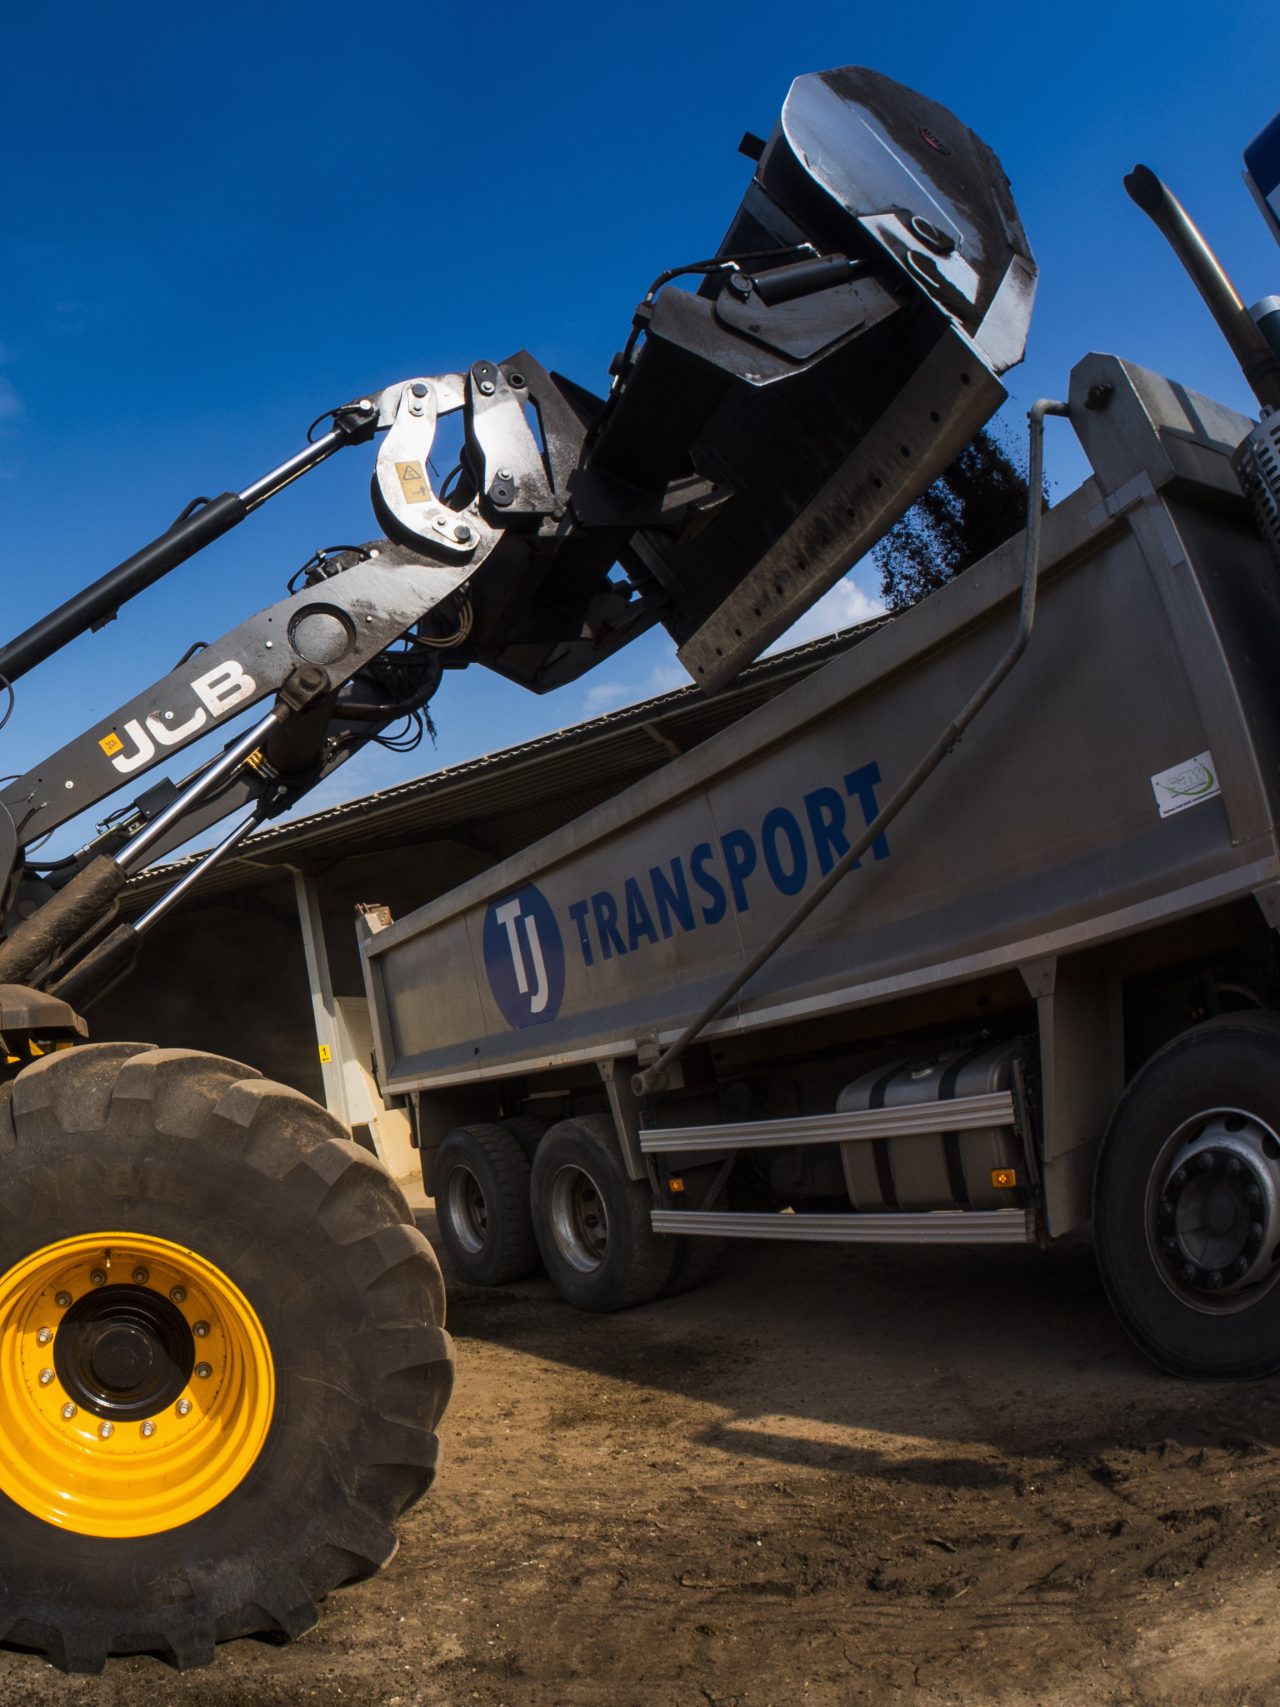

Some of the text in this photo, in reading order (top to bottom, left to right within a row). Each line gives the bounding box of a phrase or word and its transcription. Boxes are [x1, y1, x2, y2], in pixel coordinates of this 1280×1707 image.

[112, 660, 256, 773] JCB
[497, 761, 891, 1013] TJ TRANSPORT
